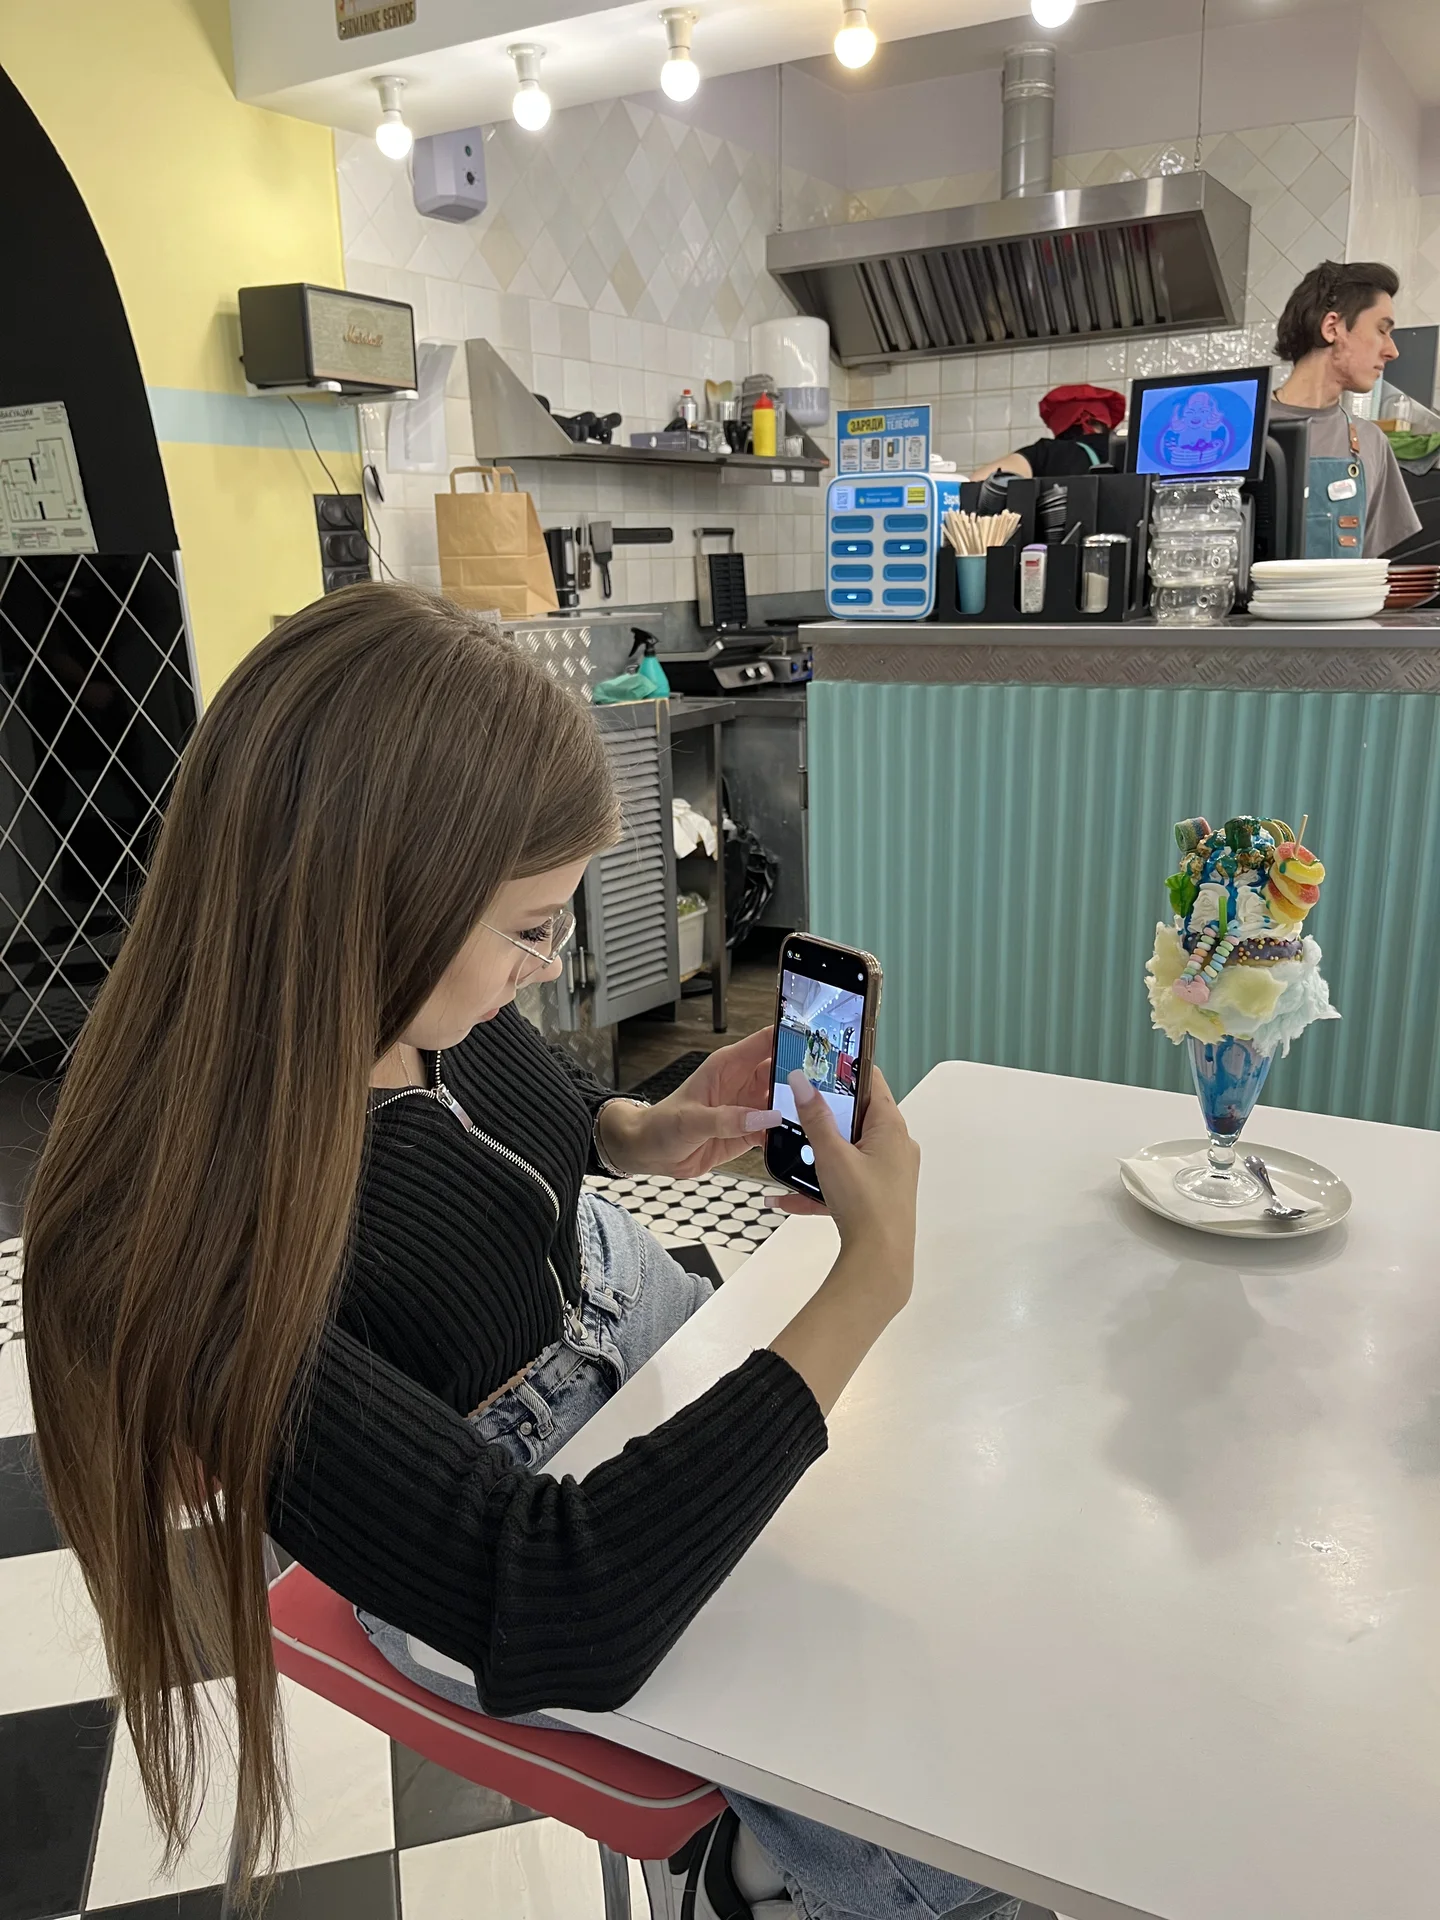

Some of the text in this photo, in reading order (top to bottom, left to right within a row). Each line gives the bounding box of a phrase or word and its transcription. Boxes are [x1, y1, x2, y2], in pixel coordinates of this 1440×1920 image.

[382, 2, 414, 29] SERVICE
[343, 324, 383, 347] Marshall
[850, 417, 919, 433] ЗАРЯДИ ТЕЛЕФОН
